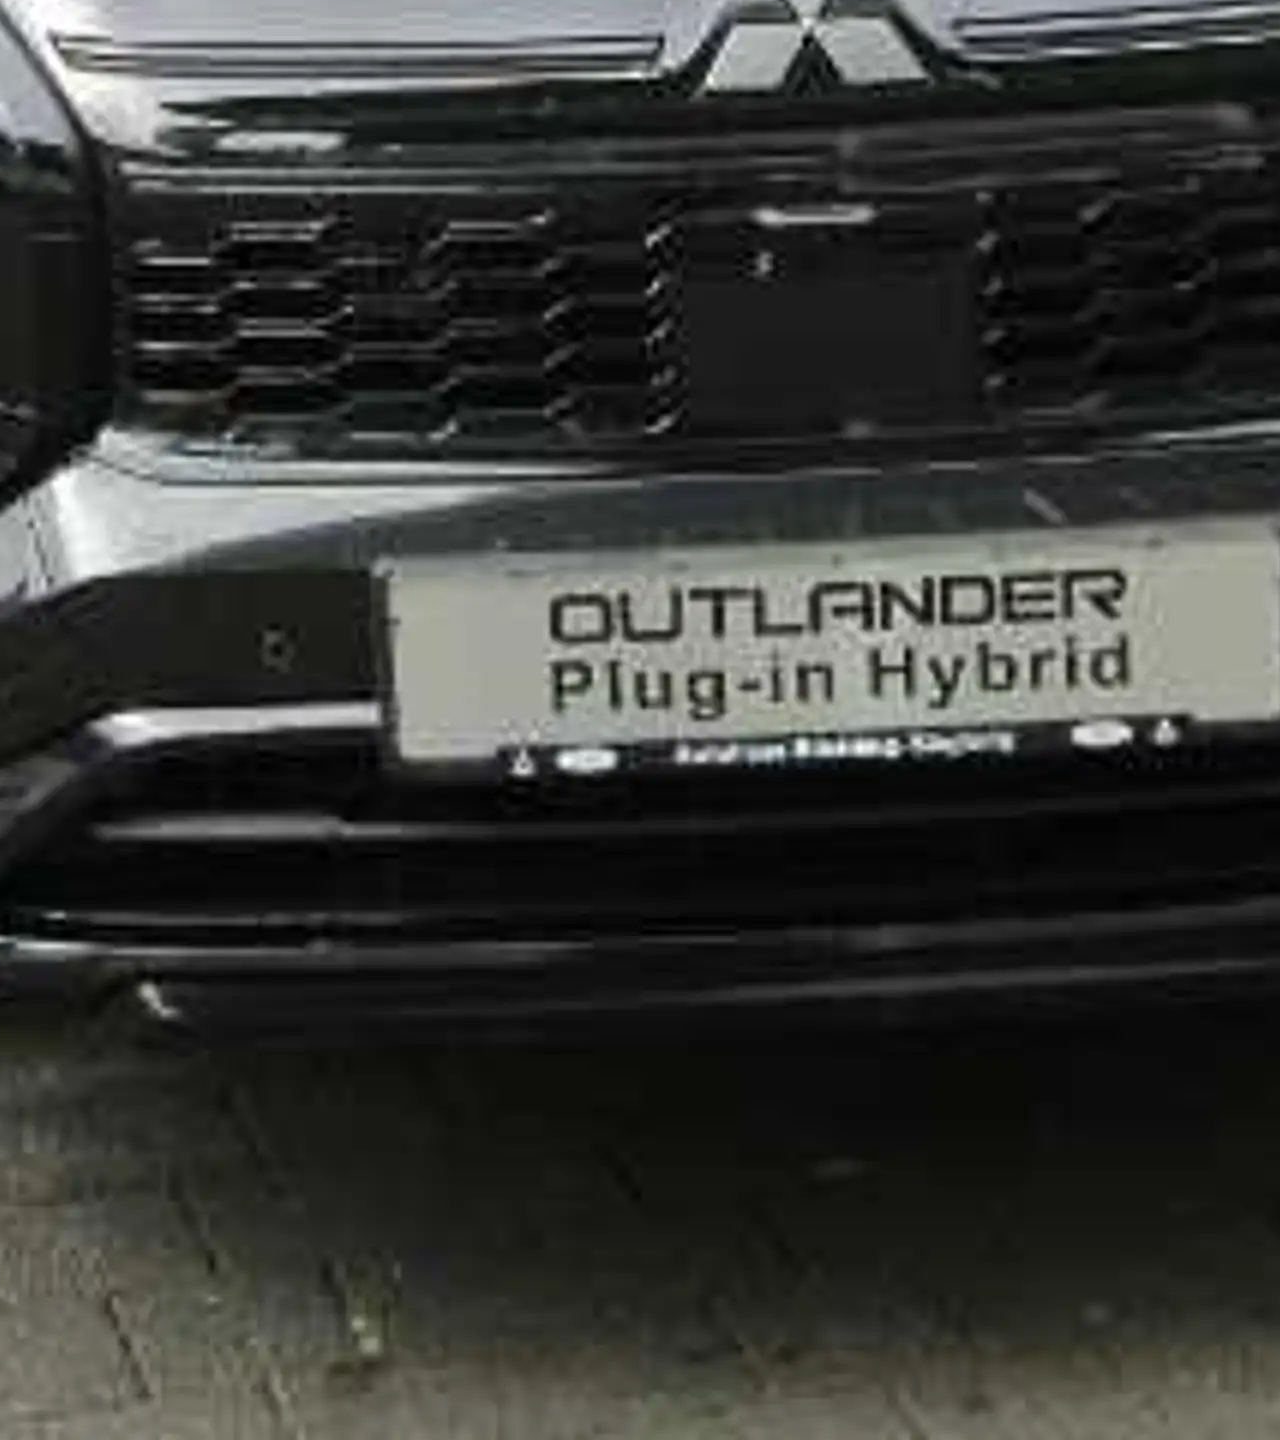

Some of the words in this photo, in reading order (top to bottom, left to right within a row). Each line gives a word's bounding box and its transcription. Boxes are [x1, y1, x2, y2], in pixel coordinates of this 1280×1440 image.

[549, 570, 1128, 644] OUTLANDER
[550, 652, 836, 720] Plug-in
[869, 636, 1132, 710] Hybrid
